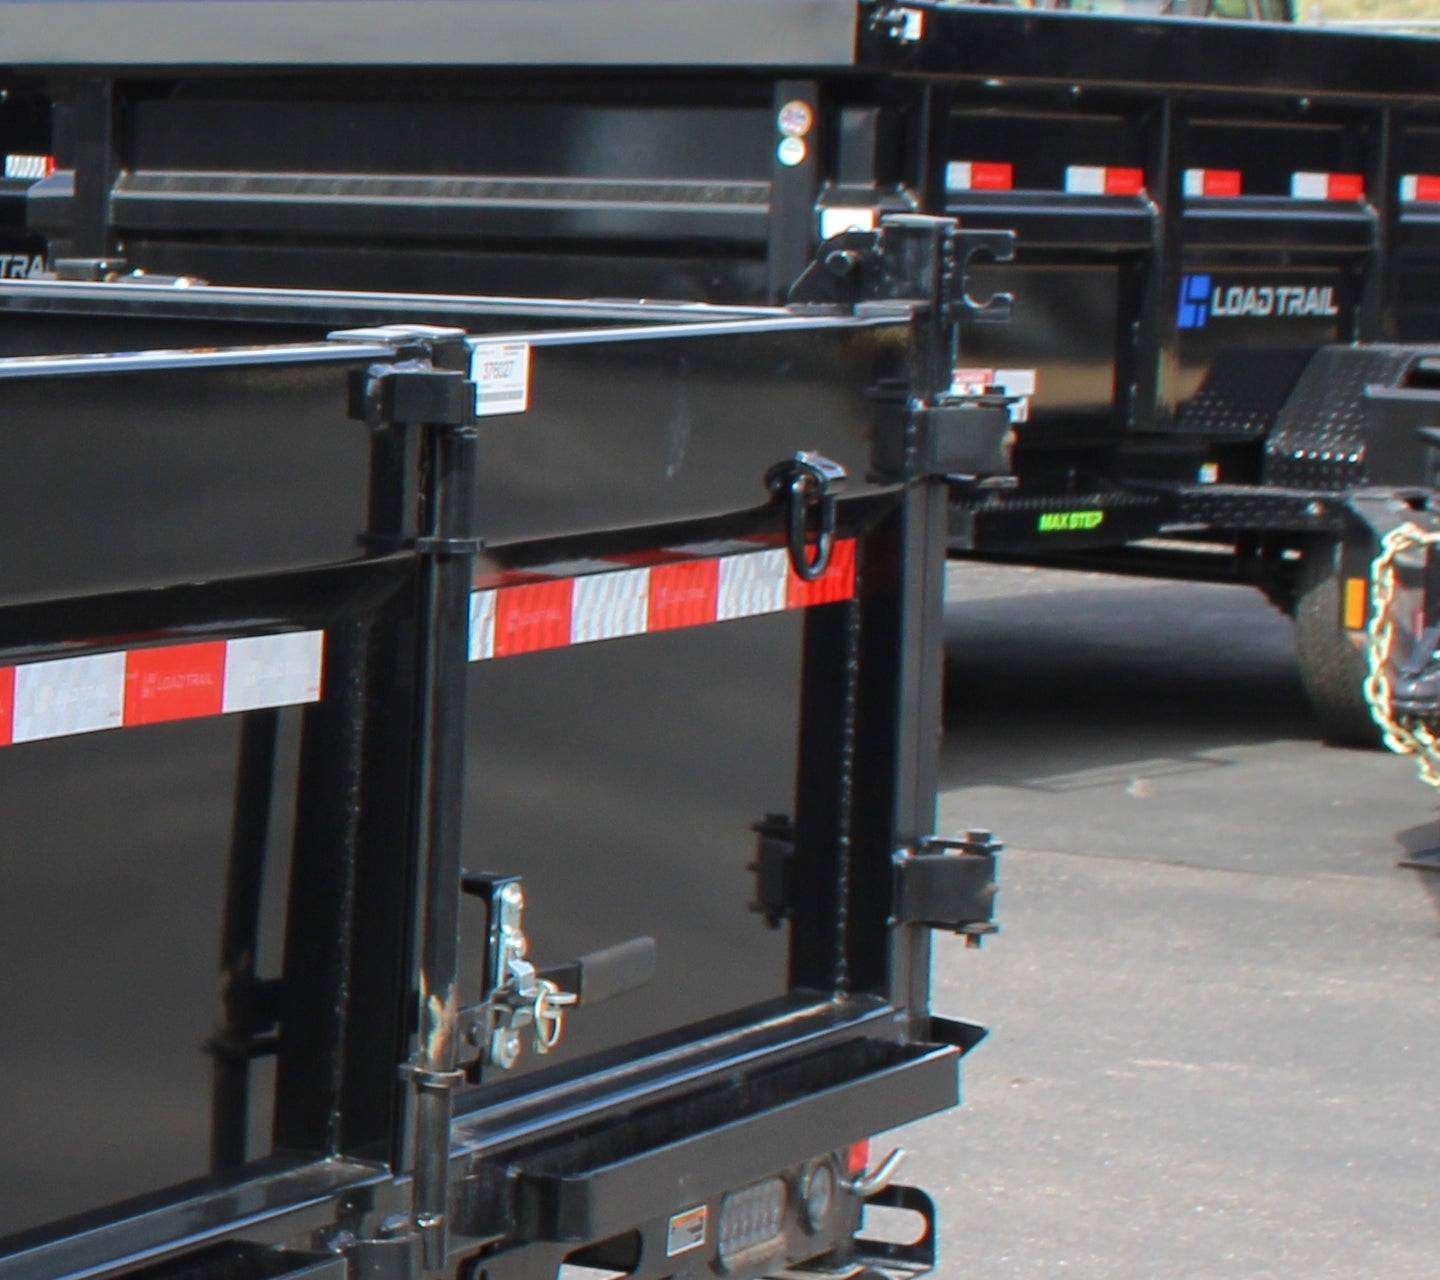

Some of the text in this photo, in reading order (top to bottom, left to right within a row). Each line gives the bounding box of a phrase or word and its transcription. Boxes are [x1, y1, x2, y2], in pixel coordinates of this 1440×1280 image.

[1211, 285, 1340, 317] LOAD TRAIL
[1038, 510, 1105, 533] MAX STEP
